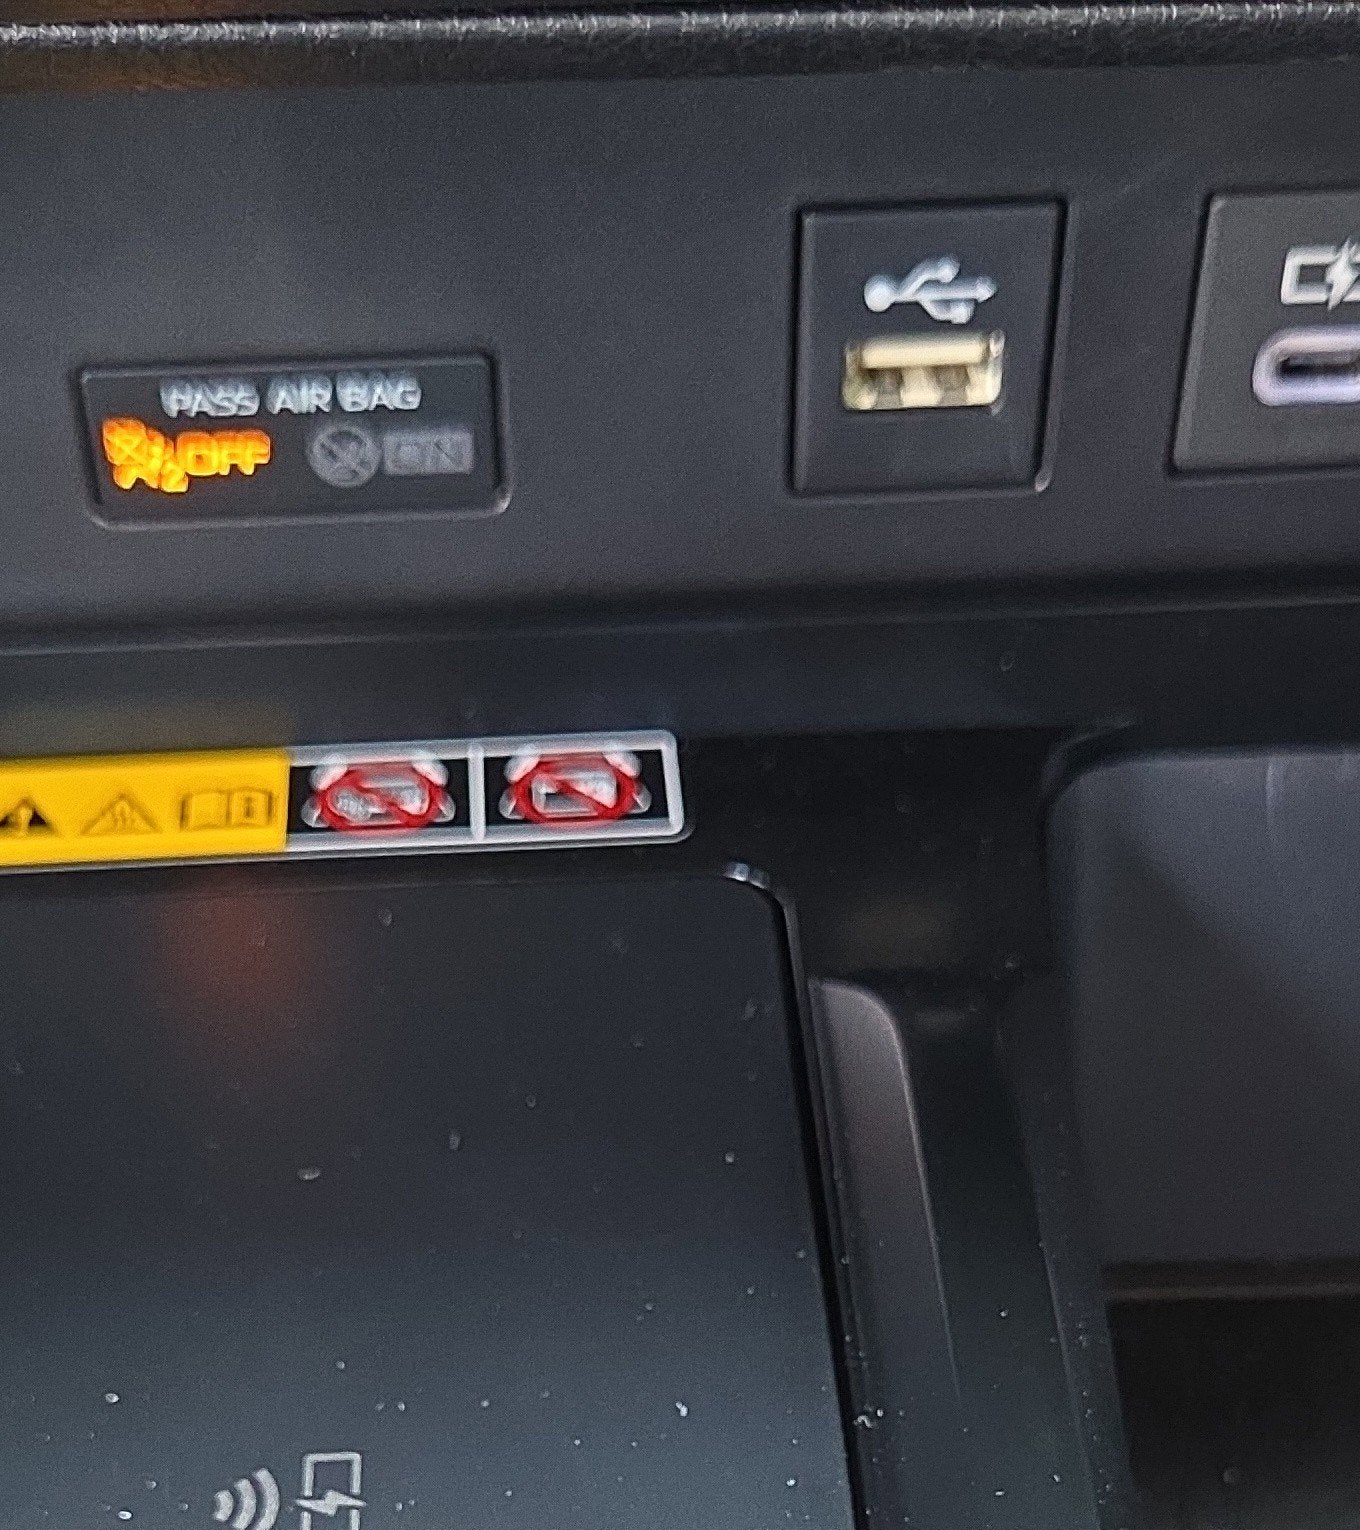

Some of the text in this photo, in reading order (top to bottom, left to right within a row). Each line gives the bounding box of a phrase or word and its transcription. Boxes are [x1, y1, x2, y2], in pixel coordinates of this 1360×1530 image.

[160, 369, 422, 418] PASS AIR BAG
[177, 429, 271, 476] OFF
